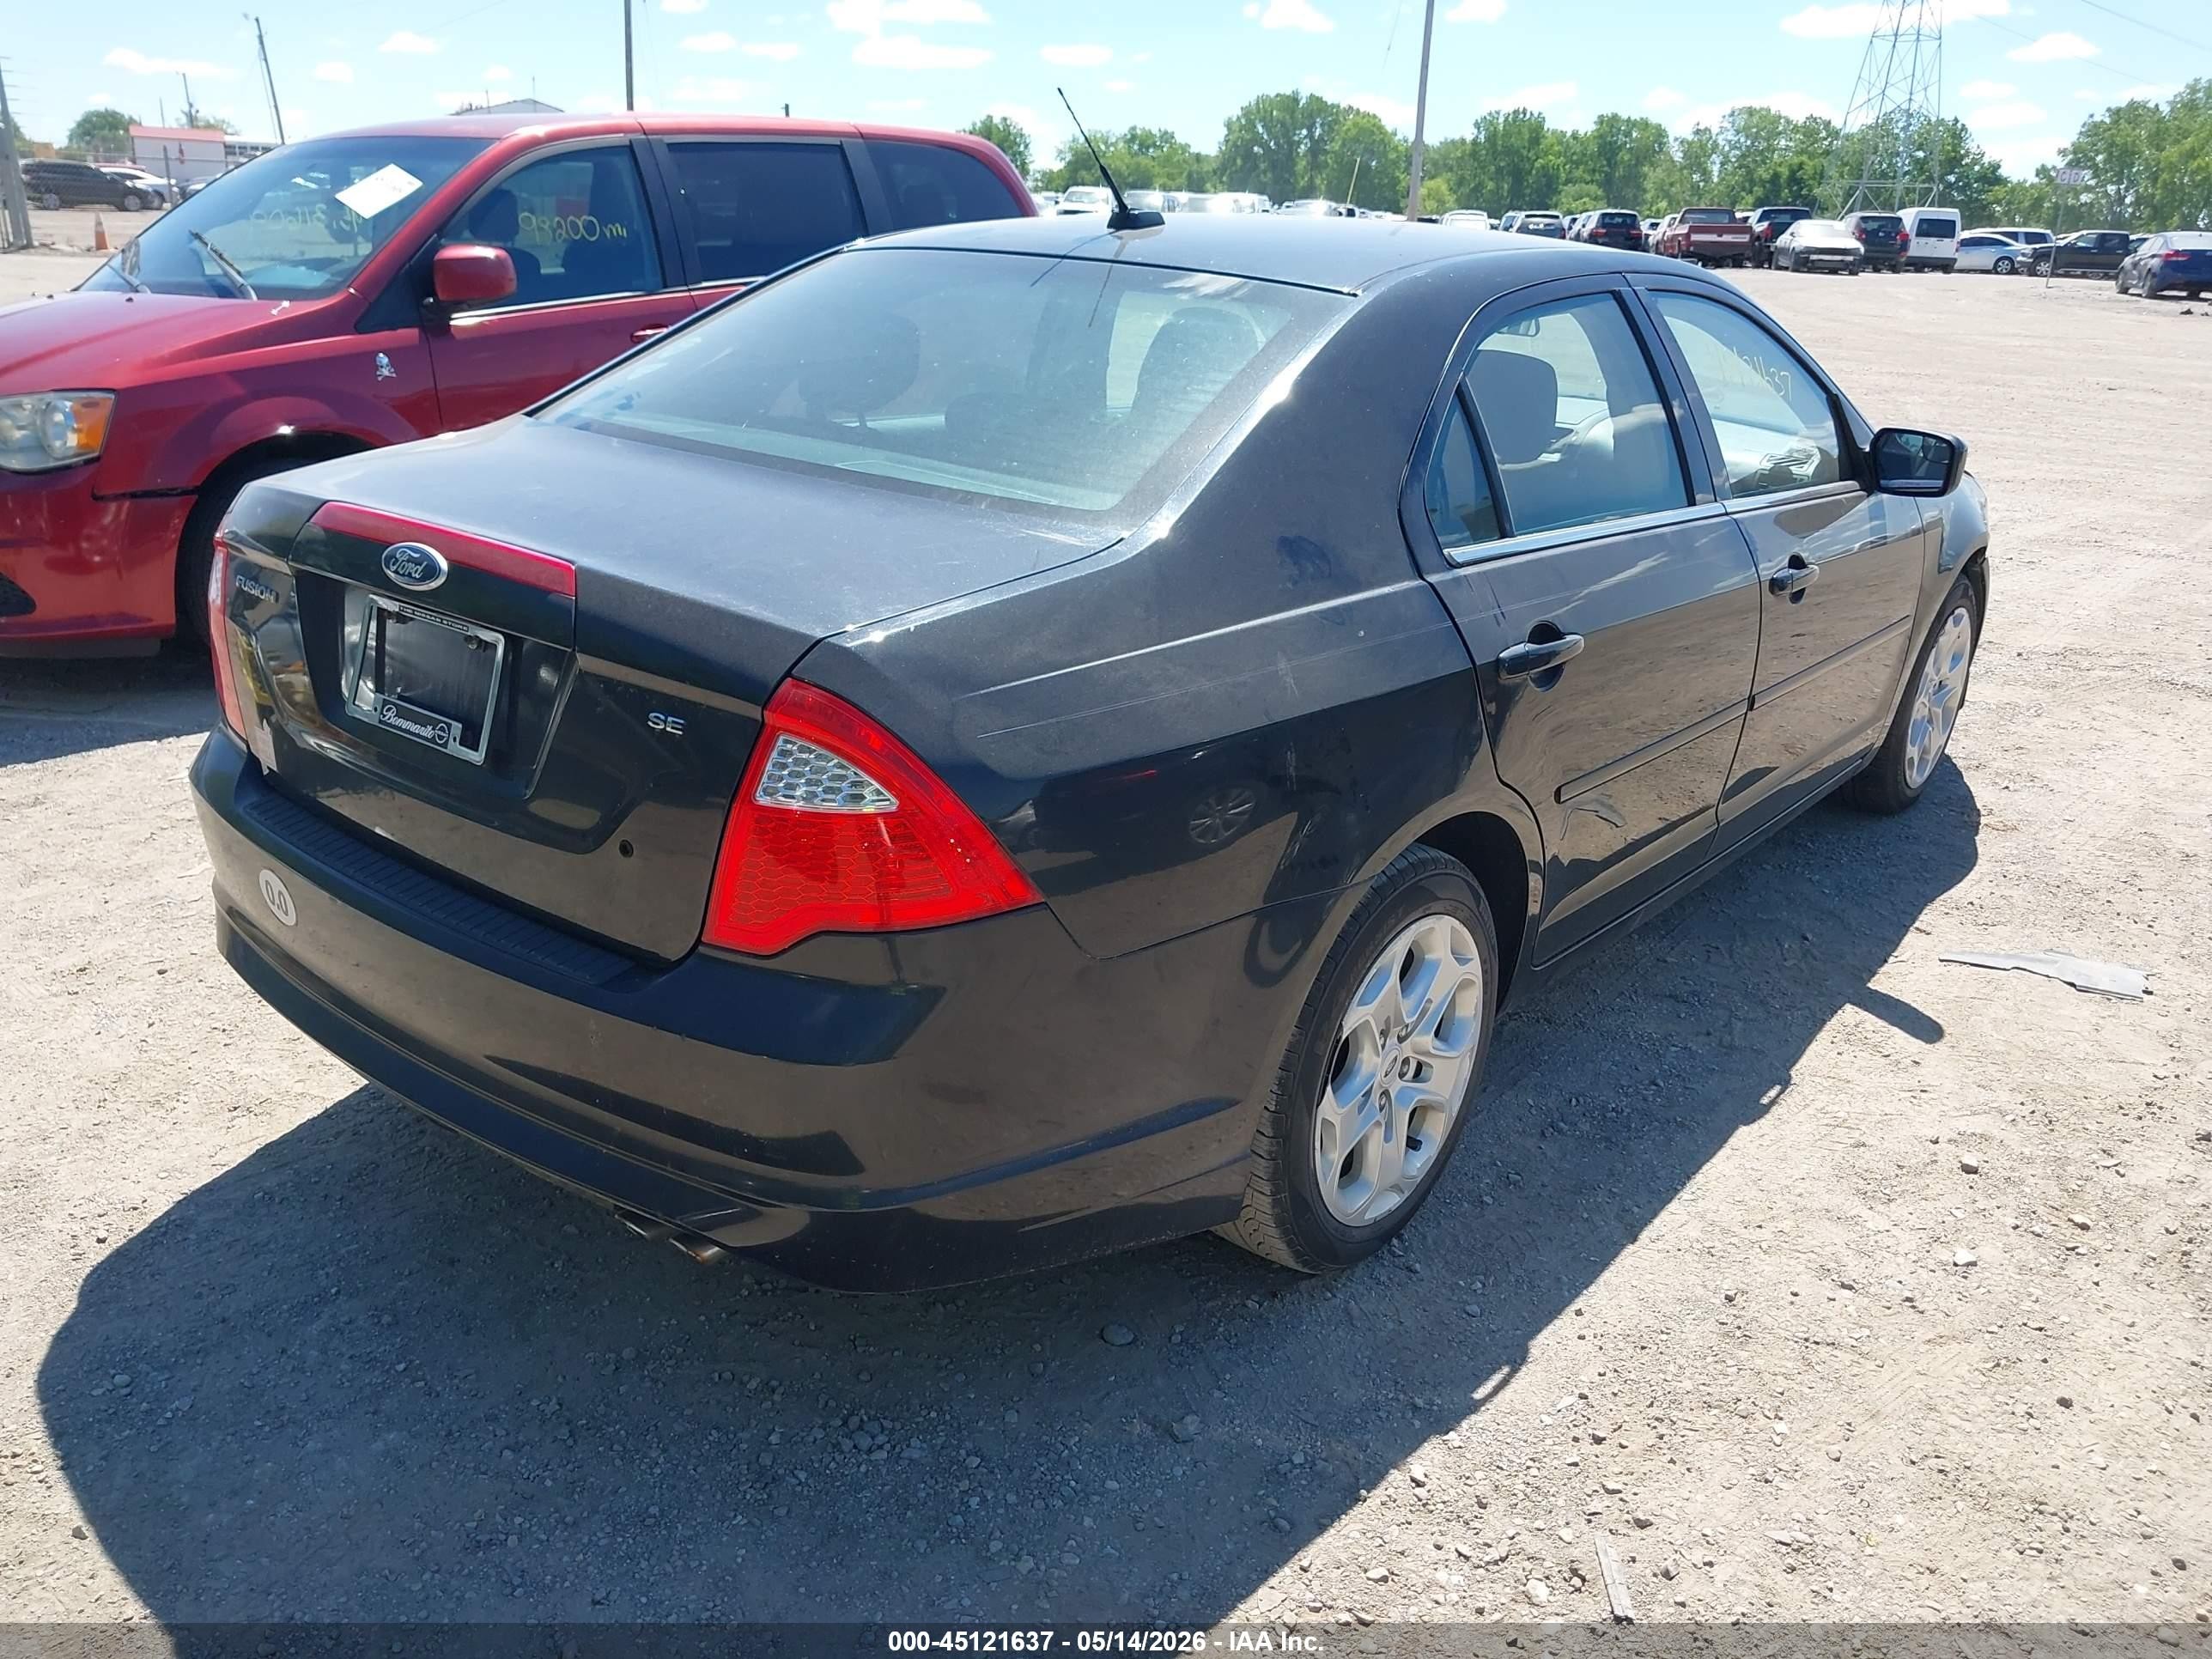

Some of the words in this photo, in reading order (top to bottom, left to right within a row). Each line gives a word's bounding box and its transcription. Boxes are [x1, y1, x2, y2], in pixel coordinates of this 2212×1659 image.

[389, 548, 428, 579] Ford
[235, 574, 279, 604] FUSION
[380, 704, 435, 739] Bommarito
[647, 713, 684, 735] SE
[264, 879, 289, 916] 0.0
